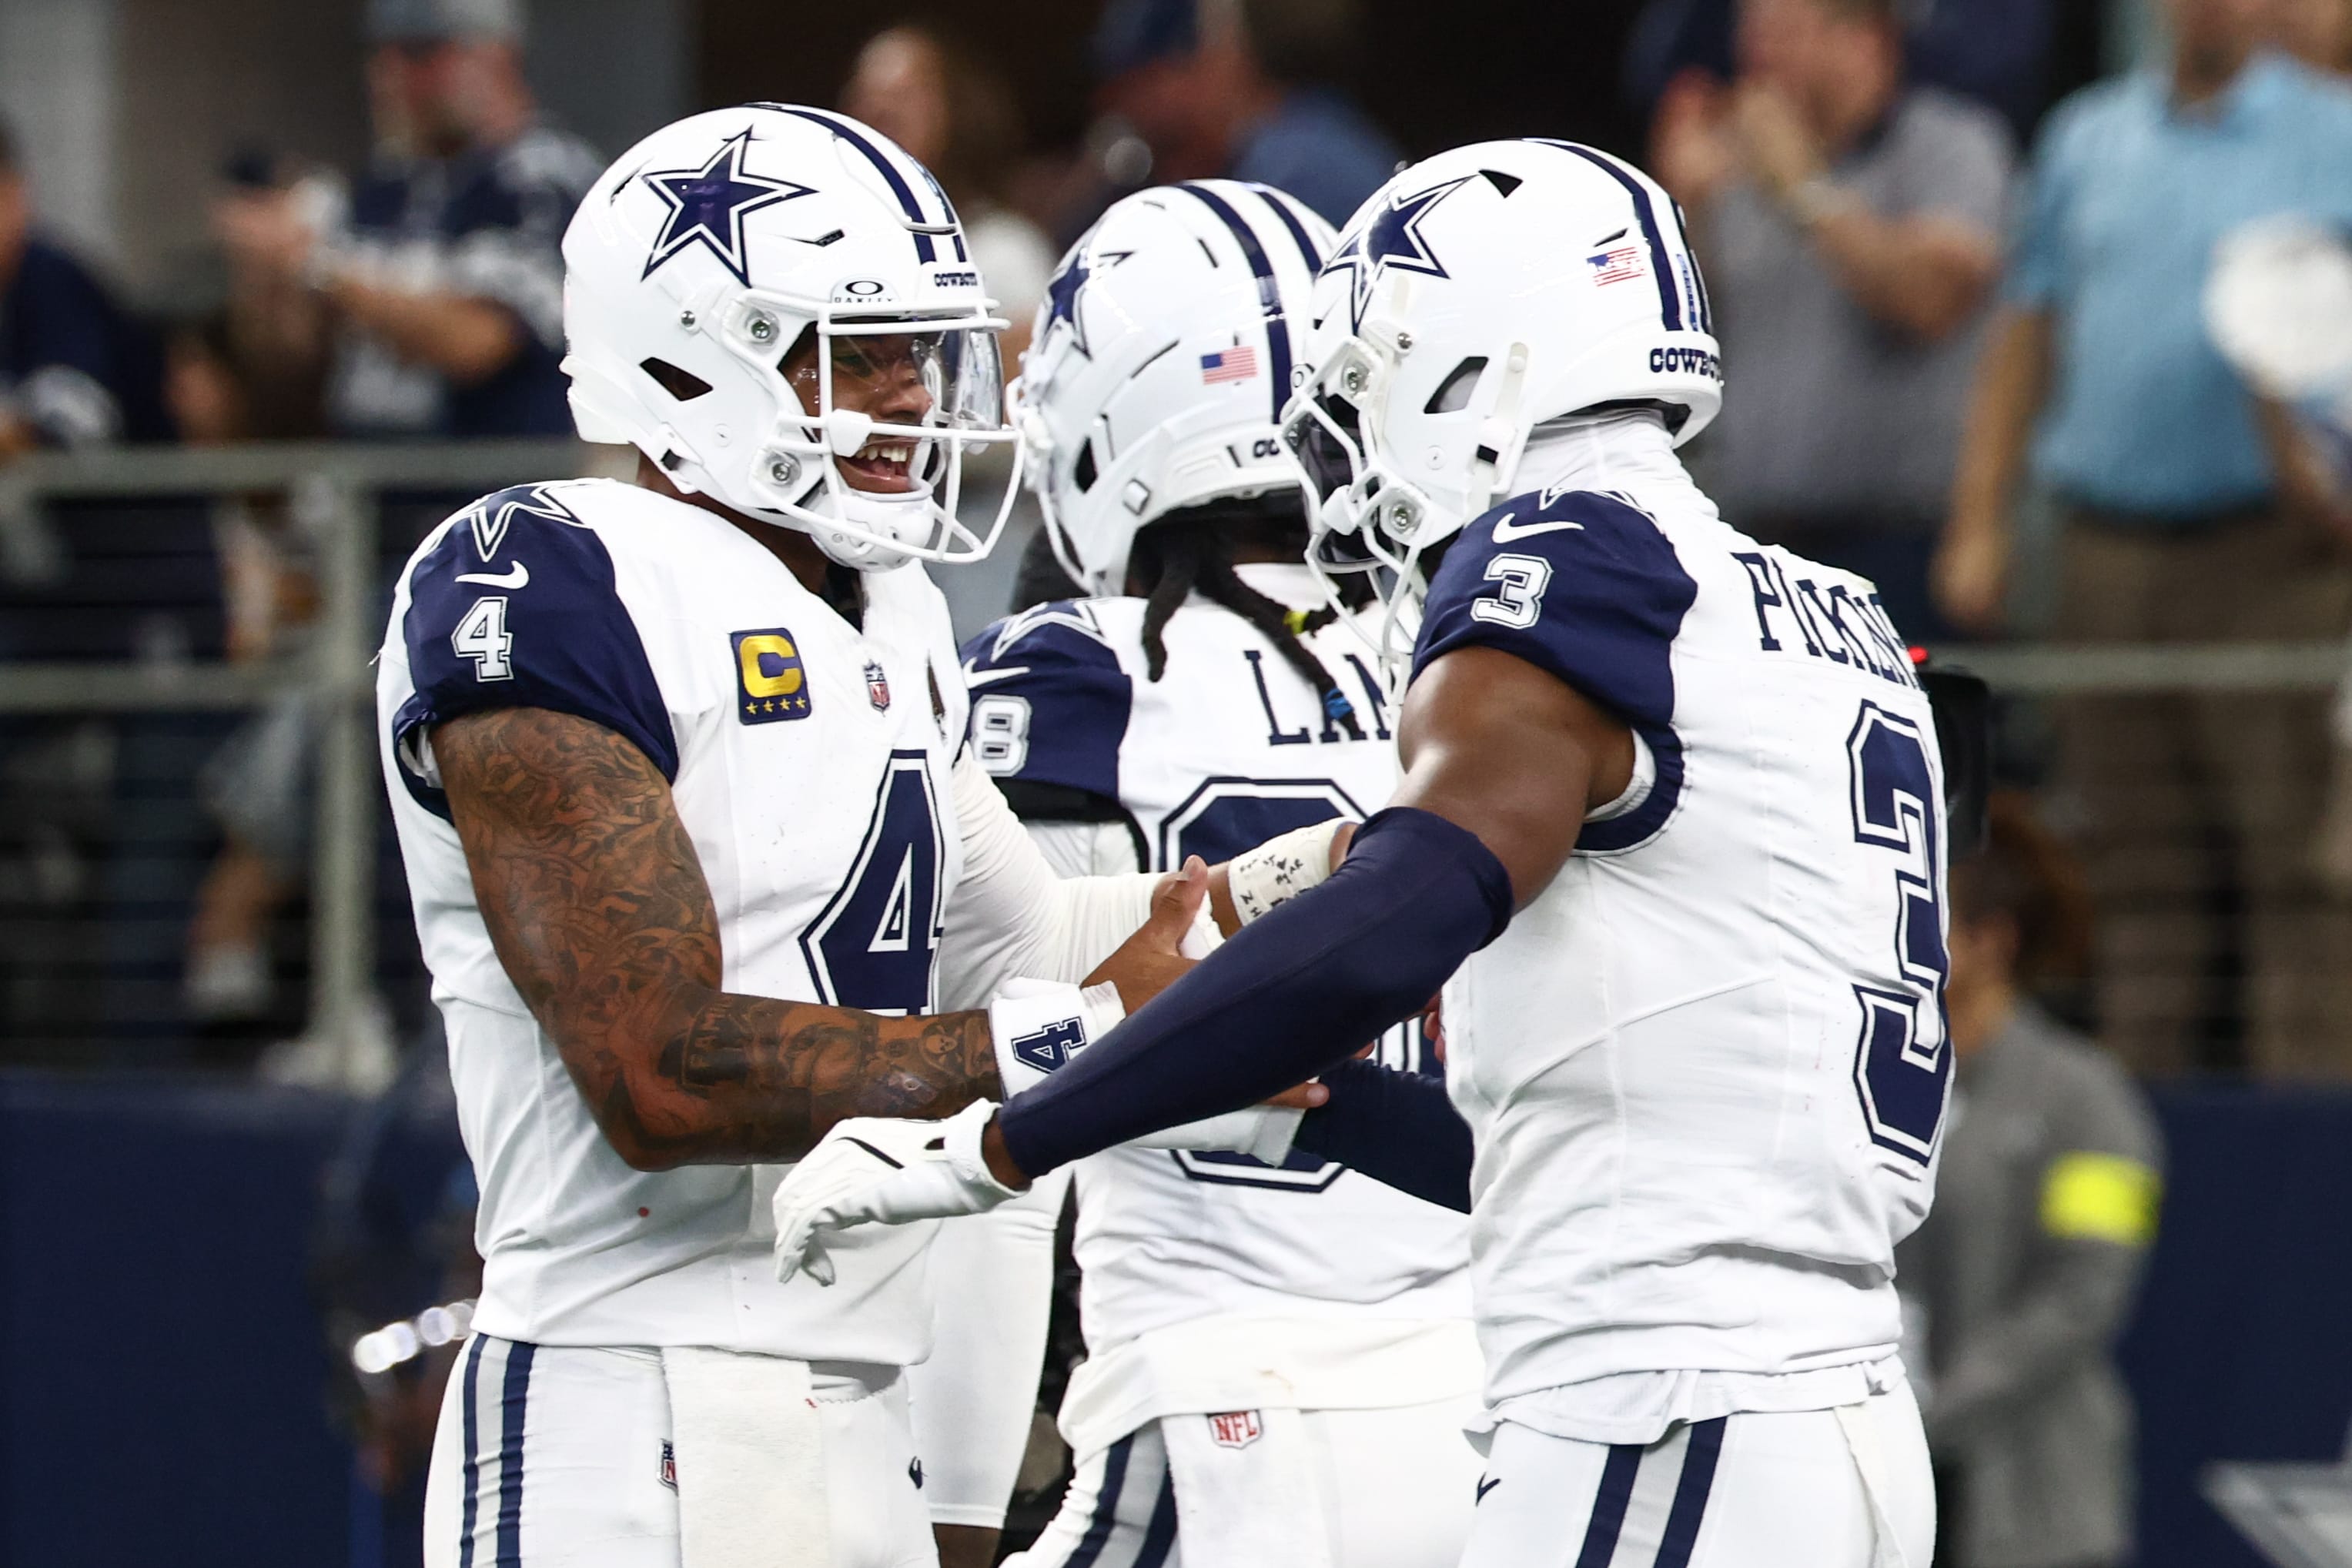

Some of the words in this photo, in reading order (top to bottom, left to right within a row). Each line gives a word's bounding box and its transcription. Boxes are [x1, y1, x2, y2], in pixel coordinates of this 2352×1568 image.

[1470, 553, 1554, 630] 3
[450, 596, 514, 683] 4
[740, 634, 802, 698] C
[798, 749, 945, 1016] 4
[1846, 699, 1952, 1168] 3
[1011, 1016, 1086, 1075] 4
[1214, 1411, 1257, 1442] NFL
